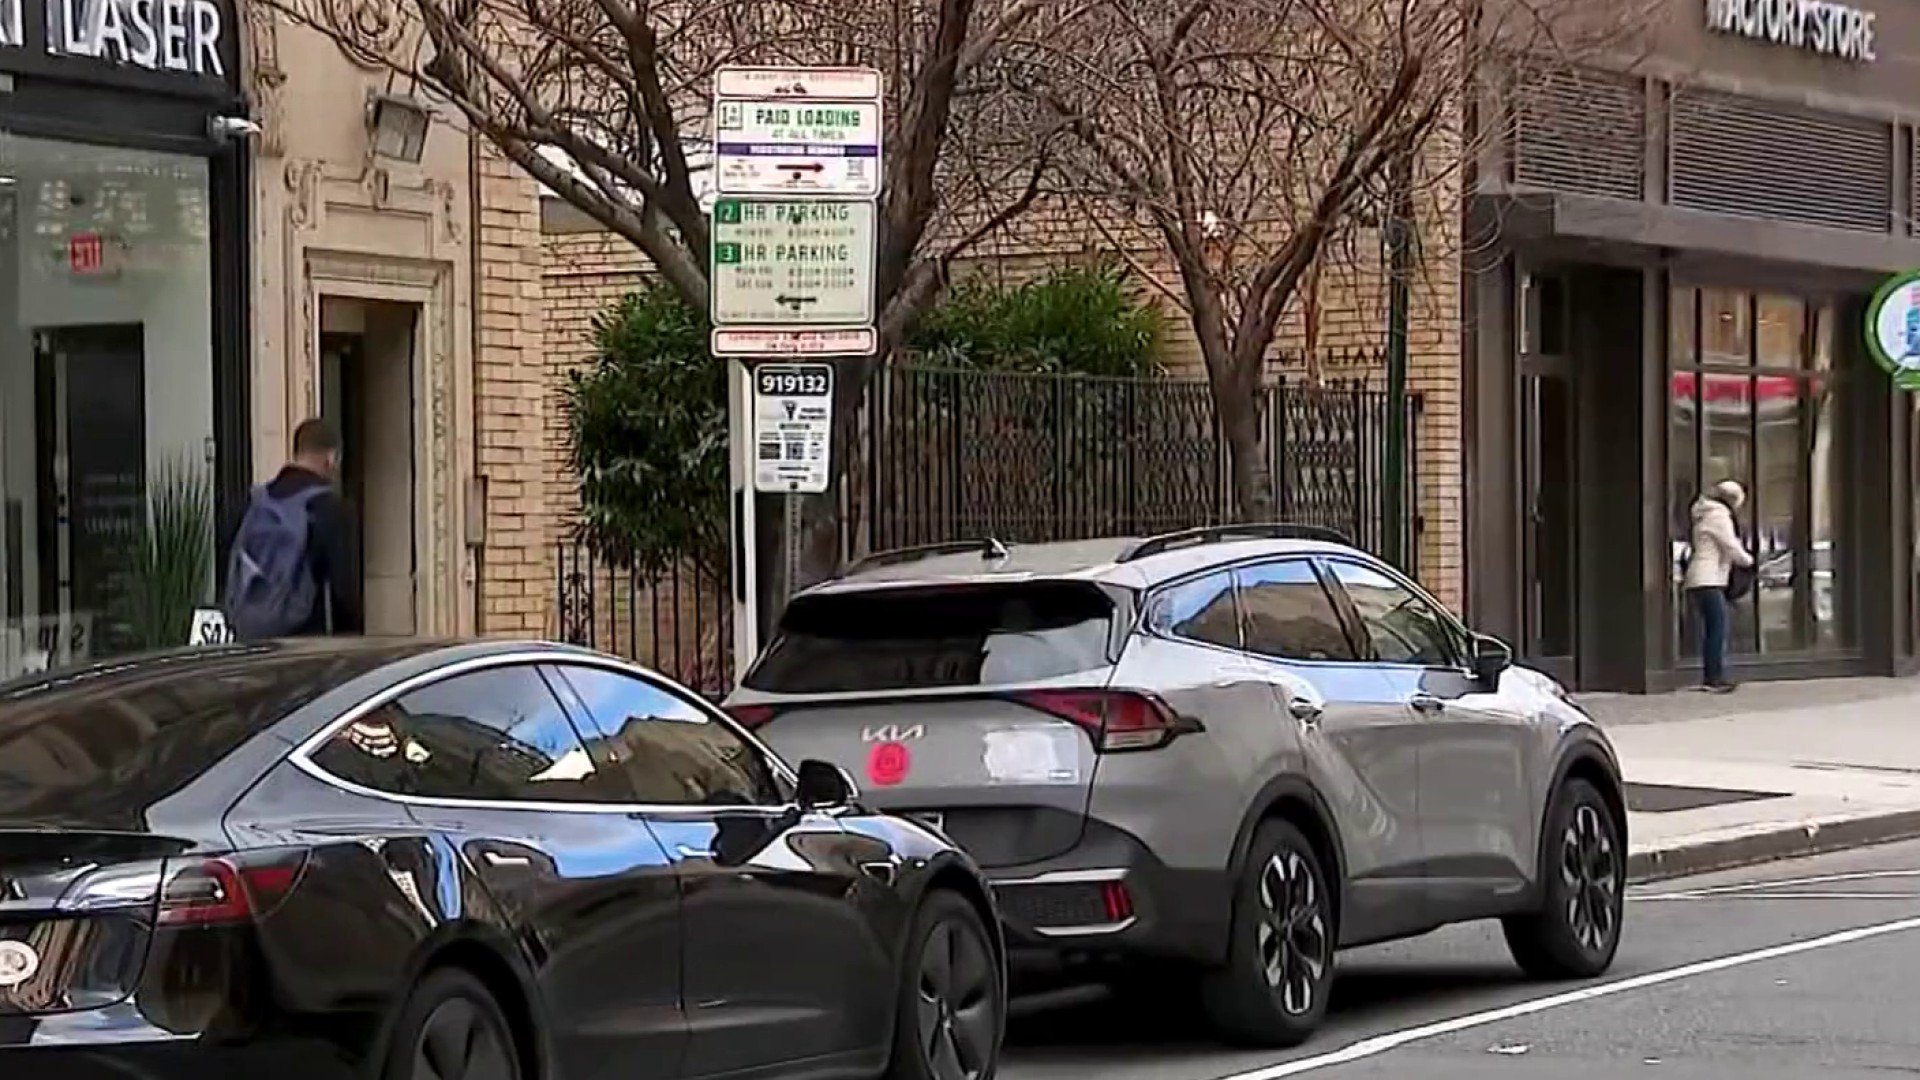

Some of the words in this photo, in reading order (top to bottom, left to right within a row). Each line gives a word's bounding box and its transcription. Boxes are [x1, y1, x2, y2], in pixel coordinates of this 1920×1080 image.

[56, 0, 224, 75] LASER
[1812, 2, 1876, 61] STORE
[756, 109, 790, 125] PAID
[797, 109, 861, 127] LOADING
[744, 205, 767, 220] HR
[776, 205, 849, 221] PARKING
[723, 245, 734, 261] 3
[744, 244, 767, 261] HR
[776, 244, 848, 261] PARKING
[762, 375, 826, 393] 919132
[862, 723, 924, 741] KIA
